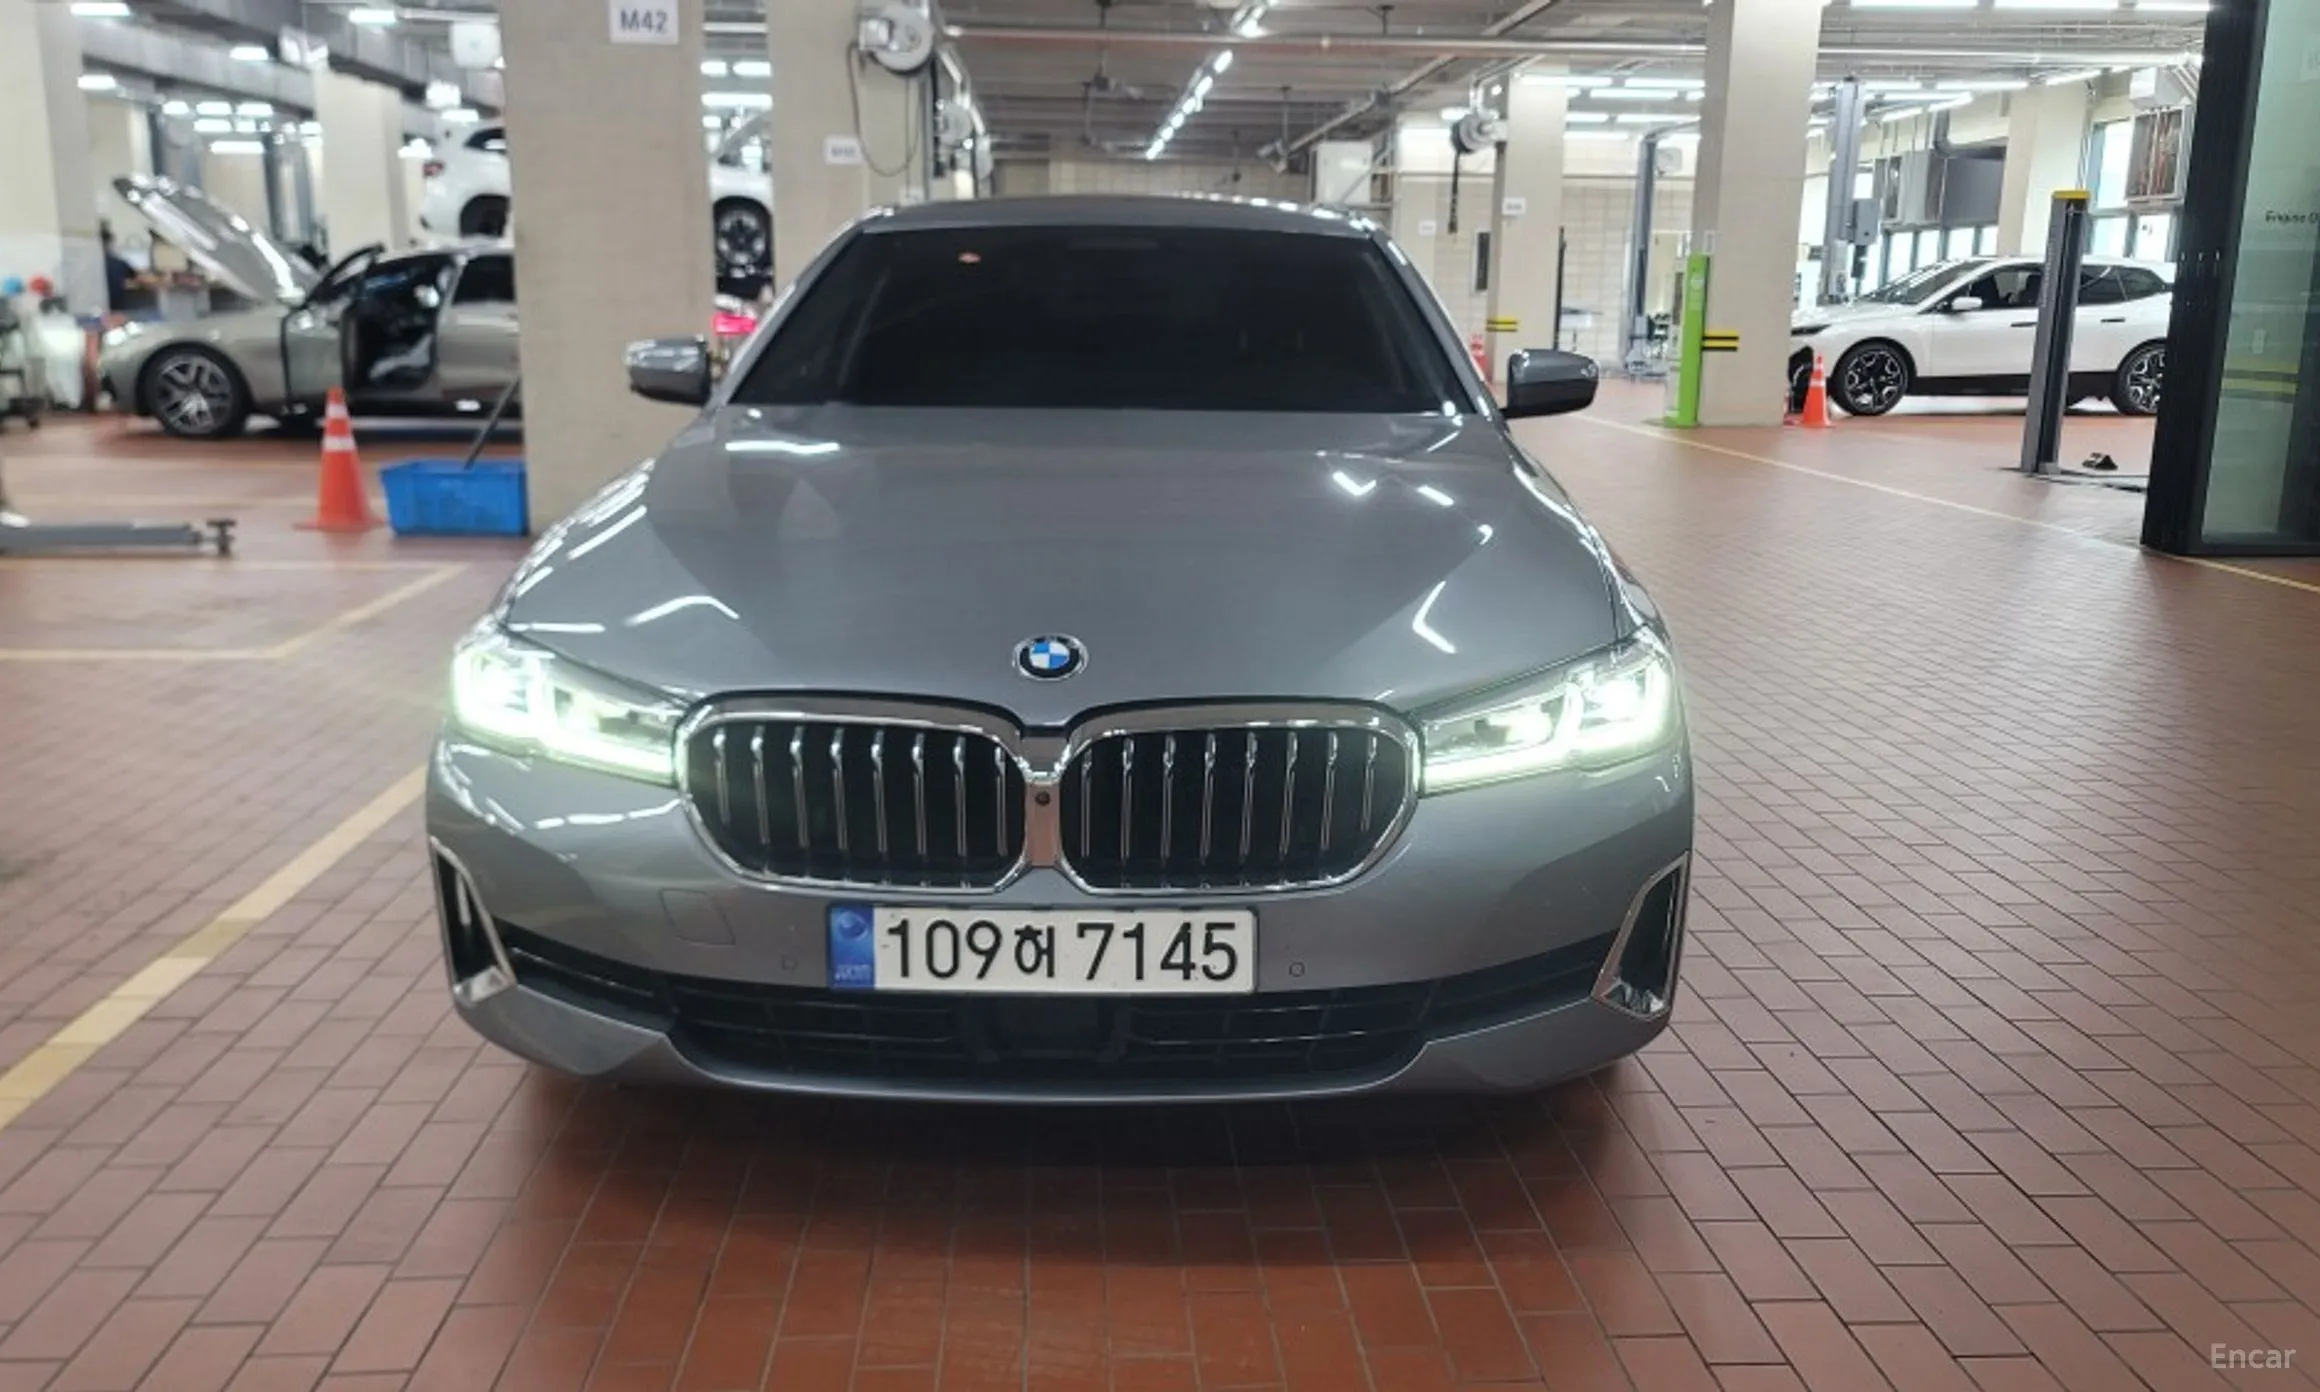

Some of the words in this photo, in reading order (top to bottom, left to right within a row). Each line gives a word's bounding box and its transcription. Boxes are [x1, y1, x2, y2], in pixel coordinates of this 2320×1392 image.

[620, 8, 669, 34] M42
[887, 918, 1055, 980] 109허
[1077, 922, 1238, 981] 7145
